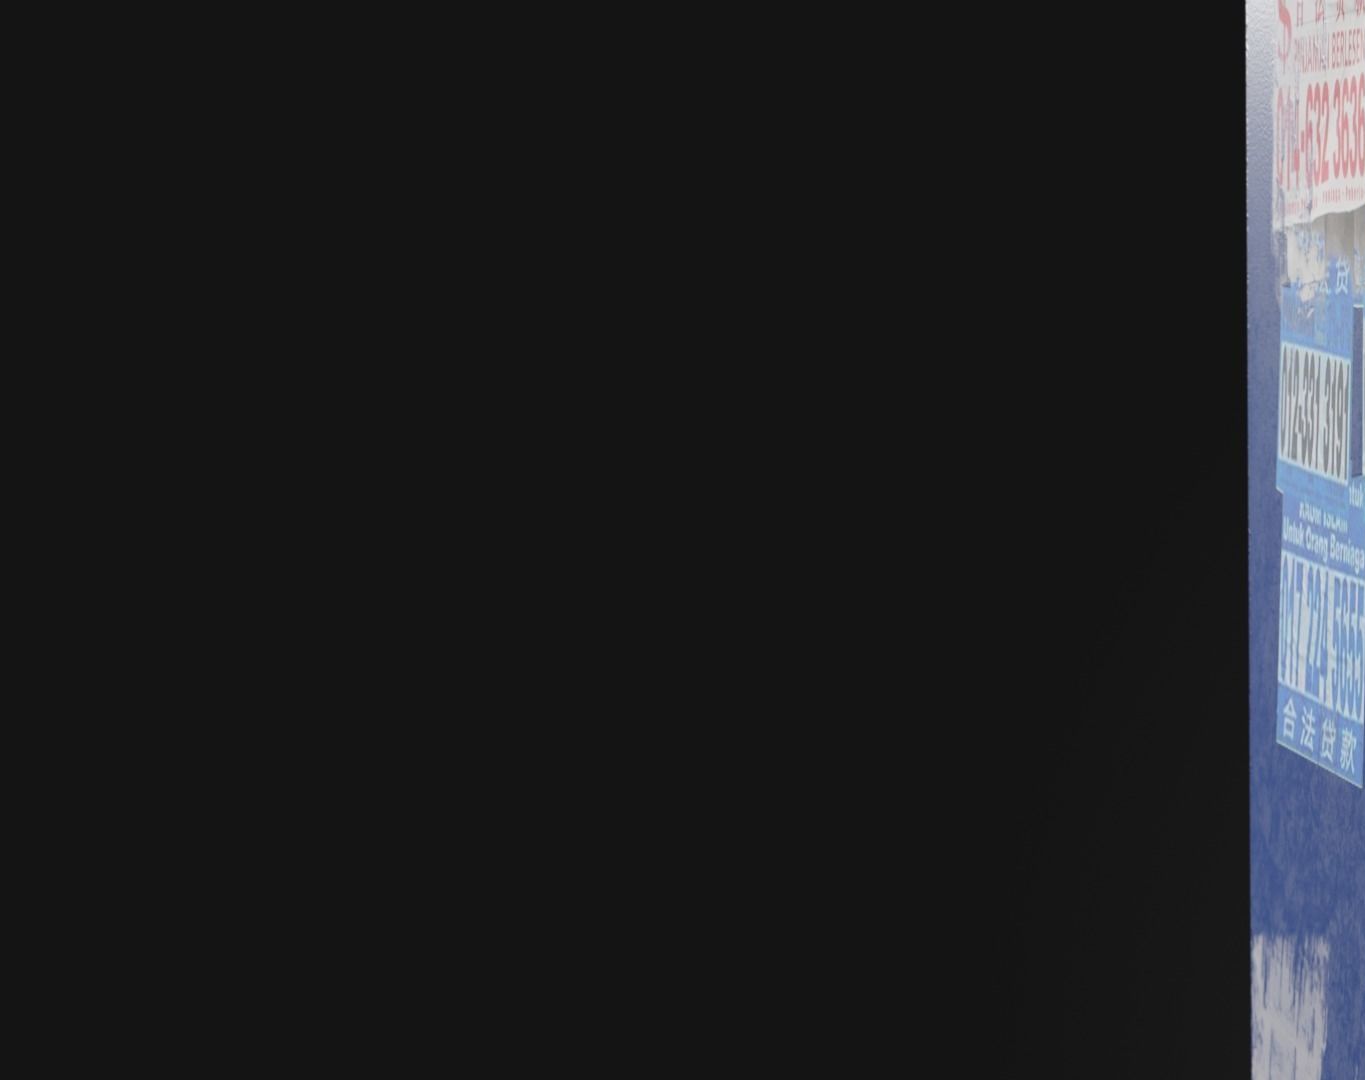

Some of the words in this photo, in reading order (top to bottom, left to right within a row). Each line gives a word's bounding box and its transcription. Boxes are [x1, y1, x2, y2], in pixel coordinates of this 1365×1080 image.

[1331, 28, 1365, 69] BERLESEN
[1333, 72, 1365, 179] 3636
[1283, 516, 1305, 545] Untuk
[1305, 526, 1328, 562] Orang
[1329, 533, 1365, 575] Berniaga
